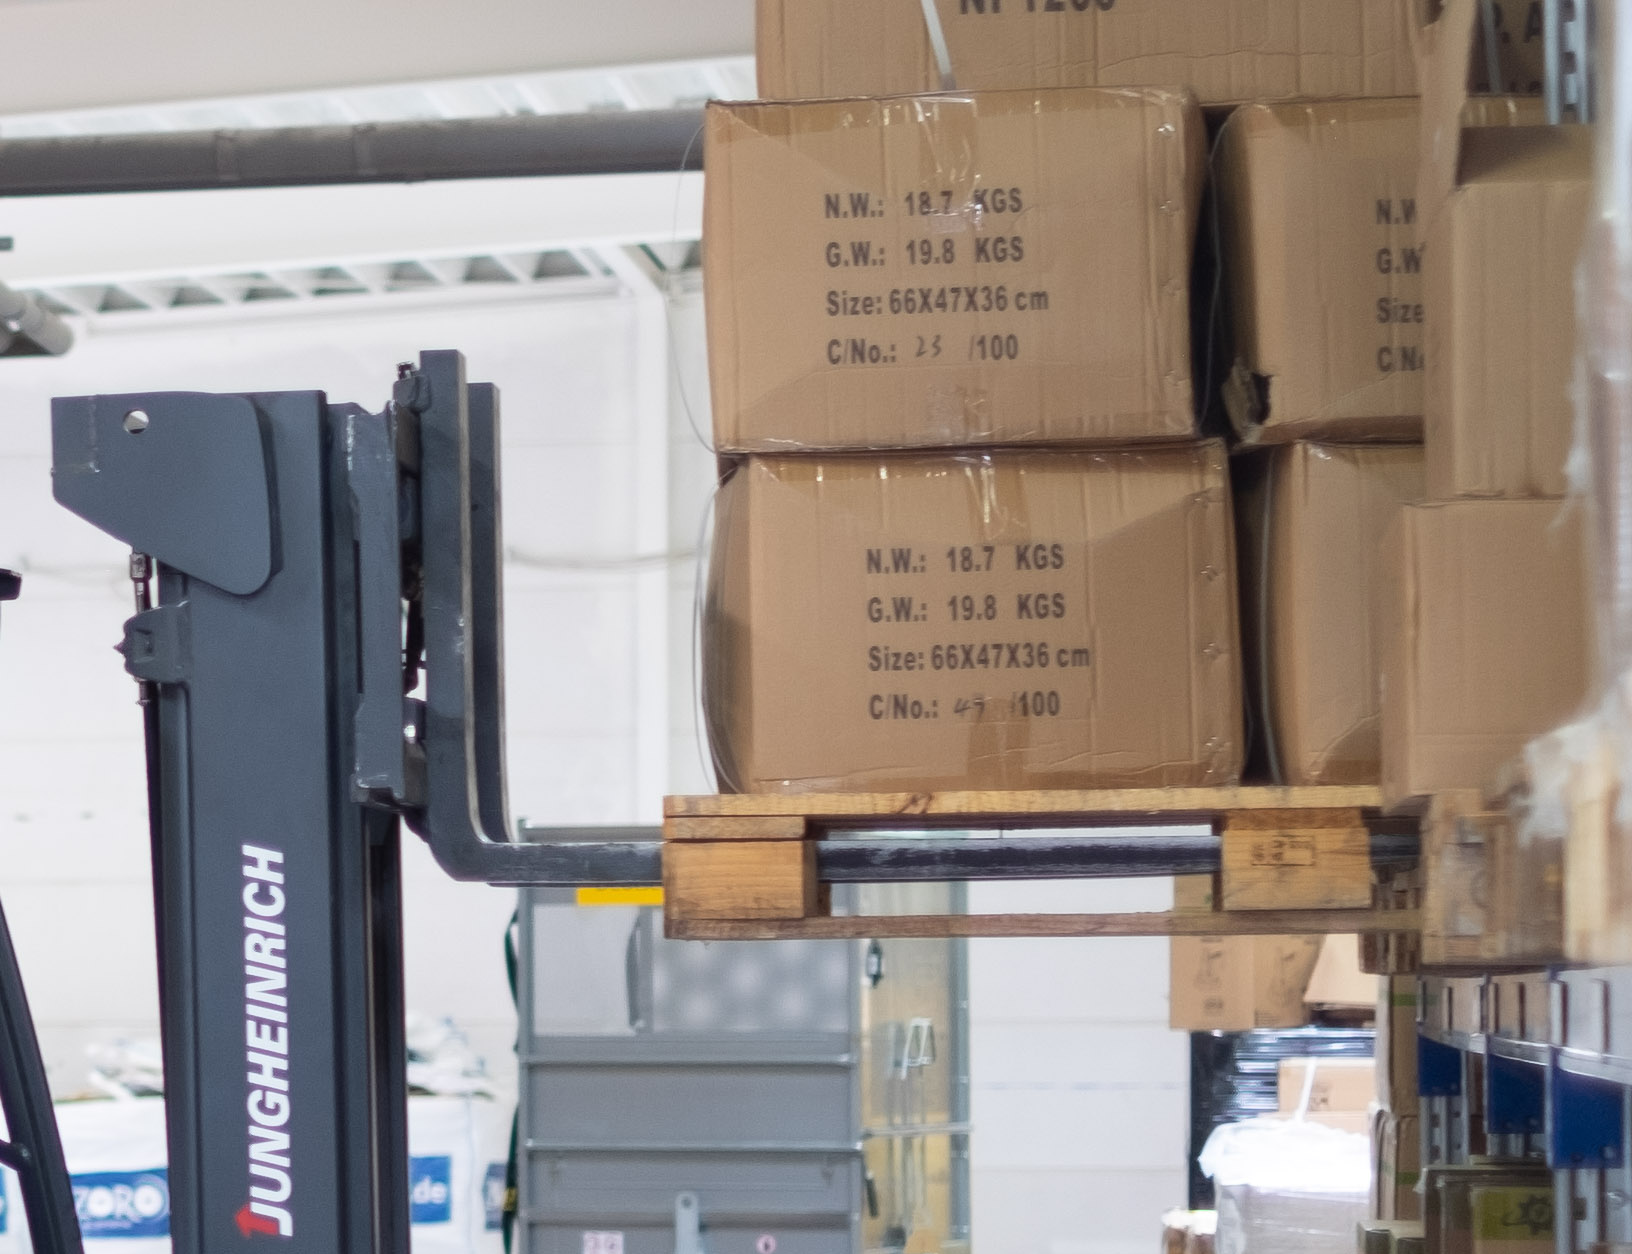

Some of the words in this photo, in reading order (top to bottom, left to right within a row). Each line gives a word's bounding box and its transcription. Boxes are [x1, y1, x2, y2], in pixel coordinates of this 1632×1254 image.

[903, 190, 954, 216] 18.7
[973, 187, 1023, 214] KGS
[824, 240, 885, 268] G.W.:
[905, 238, 956, 265] 19.8
[974, 235, 1024, 263] KGS
[826, 290, 883, 317] Size:
[888, 285, 1009, 315] 66X47X36
[1014, 289, 1050, 311] cm
[866, 547, 927, 574] N.W.:
[946, 545, 996, 573] 18.7
[1015, 543, 1065, 571] KGS
[867, 596, 928, 623] G.W.:
[947, 593, 998, 621] 19.8
[1016, 592, 1066, 620] KGS
[867, 645, 925, 672] Size:
[931, 641, 1050, 671] 66X47X36
[1055, 647, 1091, 668] cm
[240, 844, 295, 1238] JUNGHEINRICH
